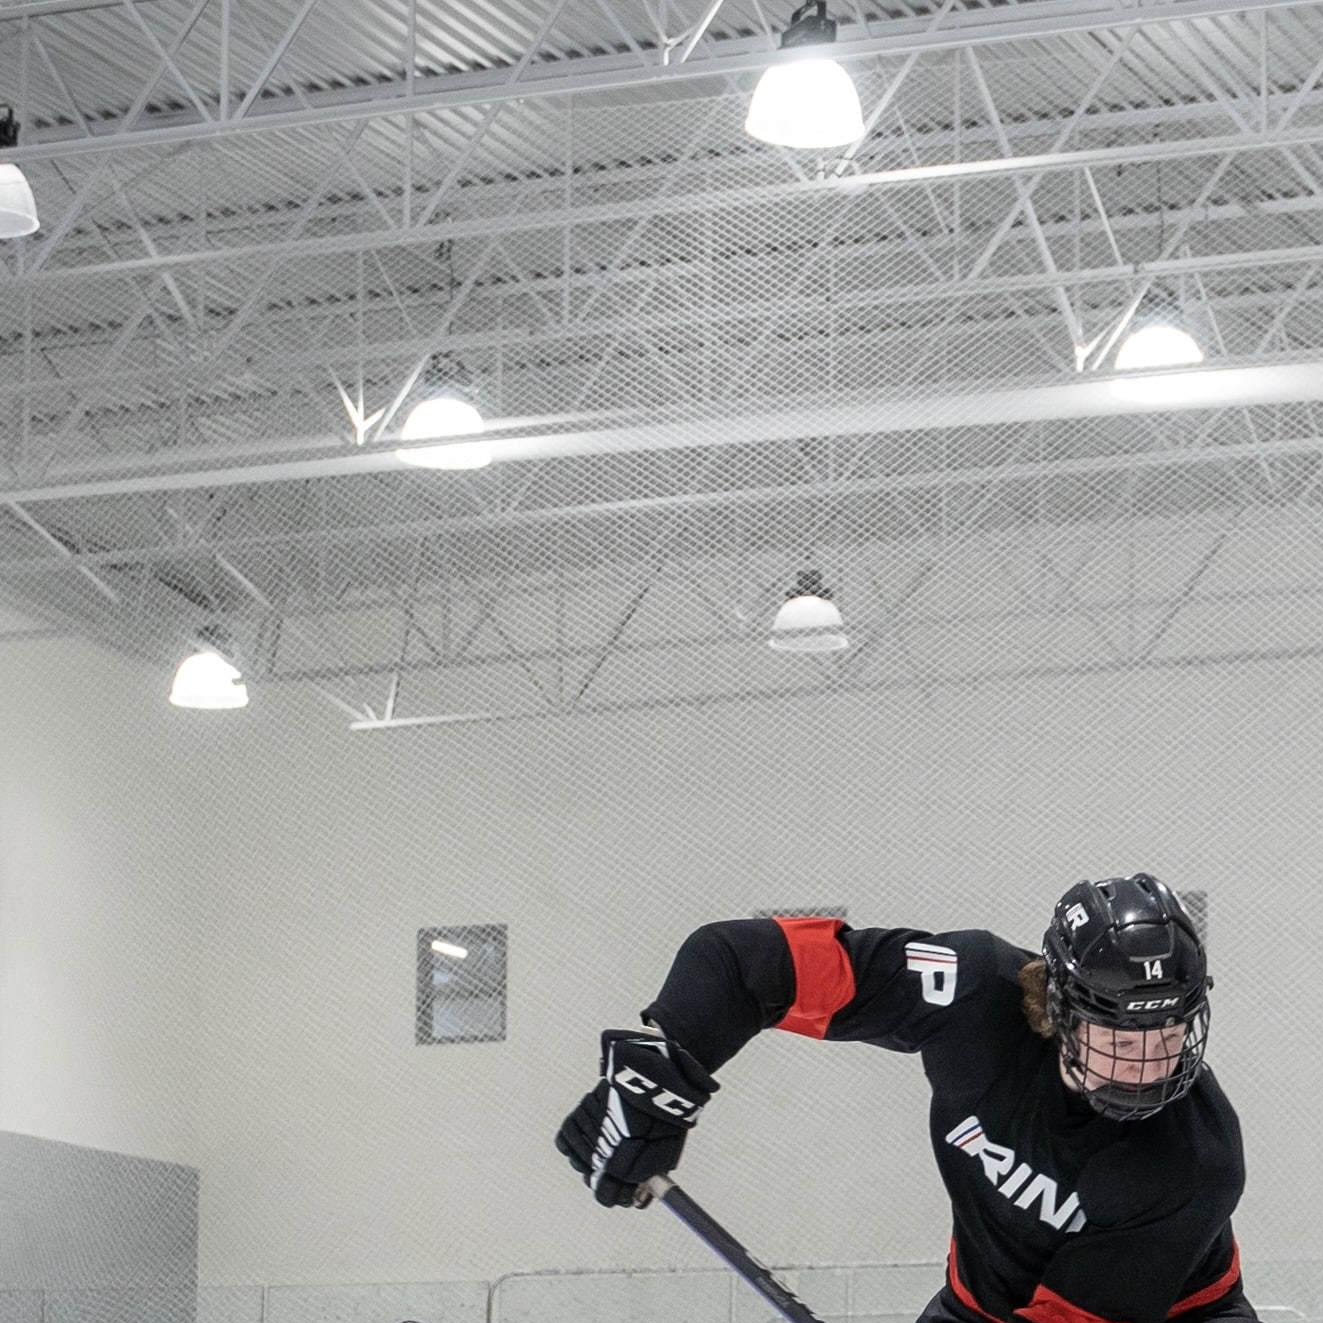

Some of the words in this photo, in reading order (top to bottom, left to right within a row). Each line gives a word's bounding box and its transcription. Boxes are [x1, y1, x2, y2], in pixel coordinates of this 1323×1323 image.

[1143, 959, 1163, 981] 14
[1126, 997, 1180, 1011] CCM
[614, 1065, 704, 1123] CC
